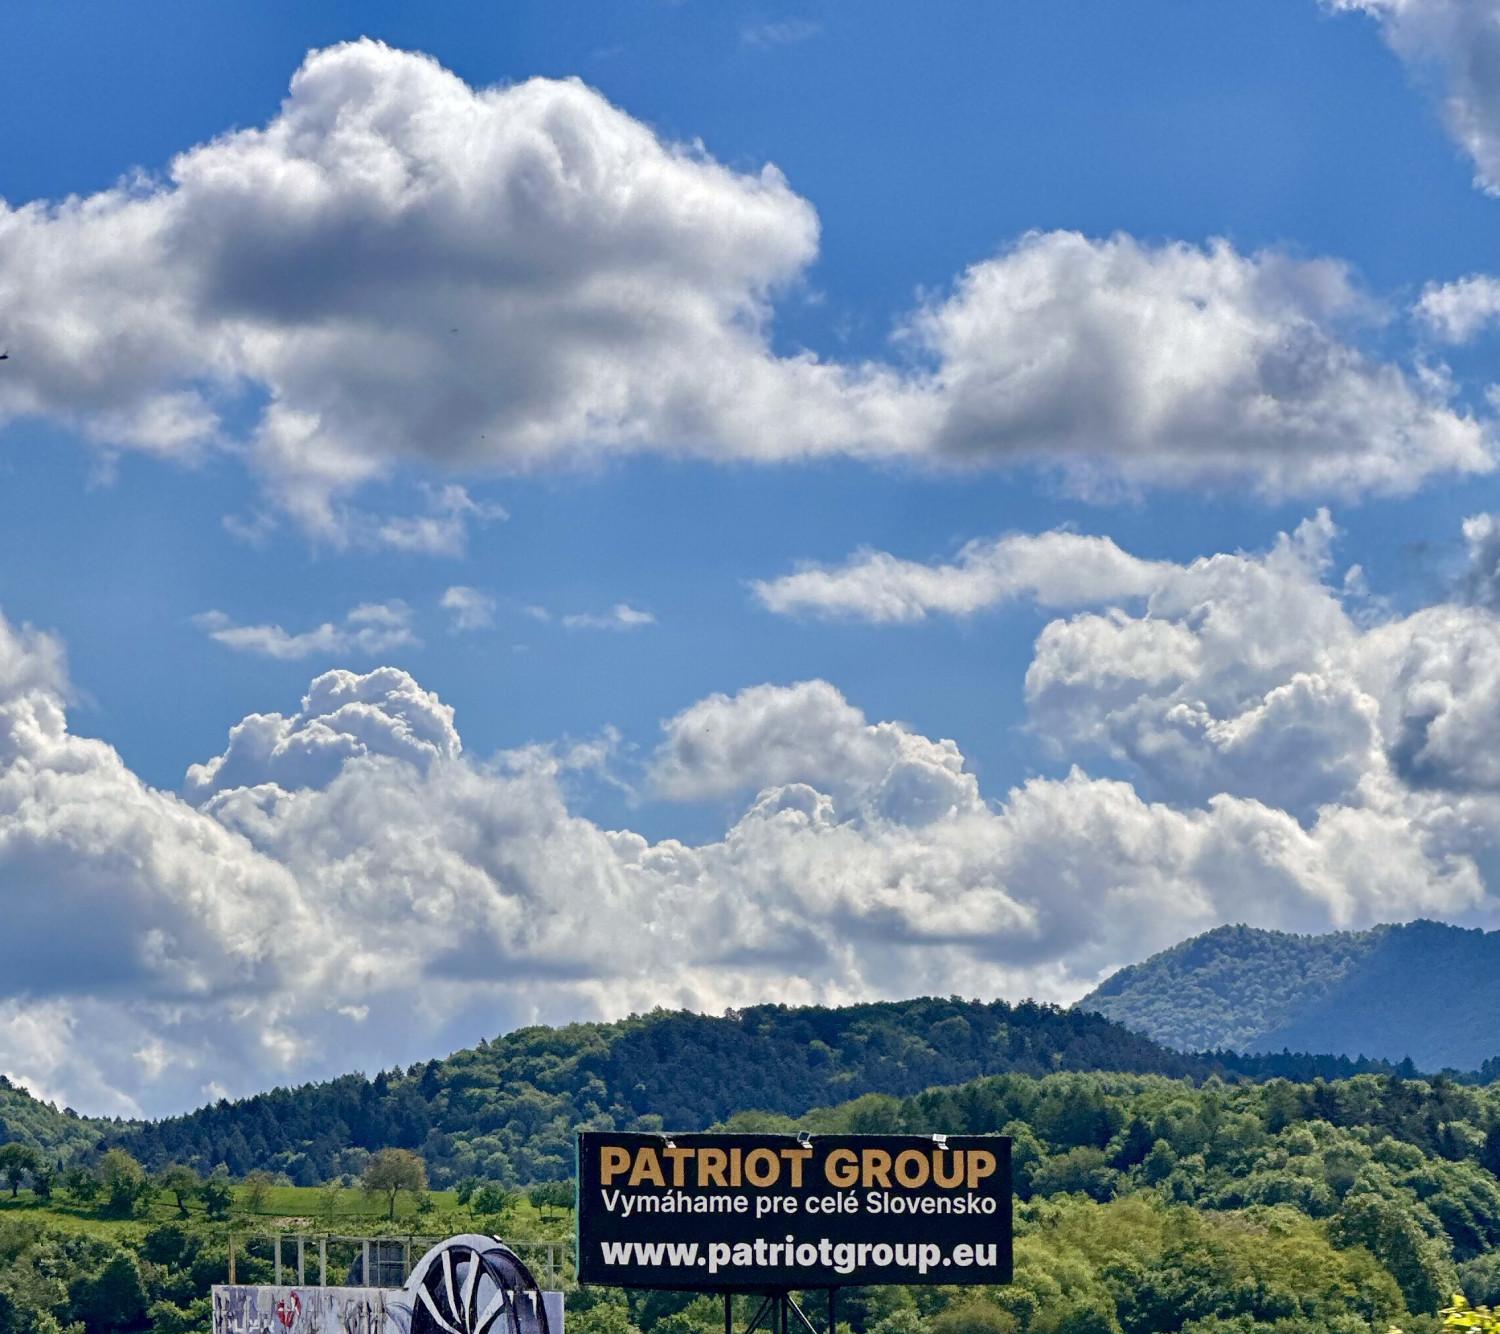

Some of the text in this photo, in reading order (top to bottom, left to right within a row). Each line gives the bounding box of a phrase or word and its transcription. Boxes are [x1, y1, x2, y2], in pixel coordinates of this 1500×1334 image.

[600, 1146, 997, 1189] PATRIOT GROUP
[601, 1190, 997, 1218] Vymáhame pre celé Slovensko
[601, 1235, 997, 1273] www.patriotgroup.eu
